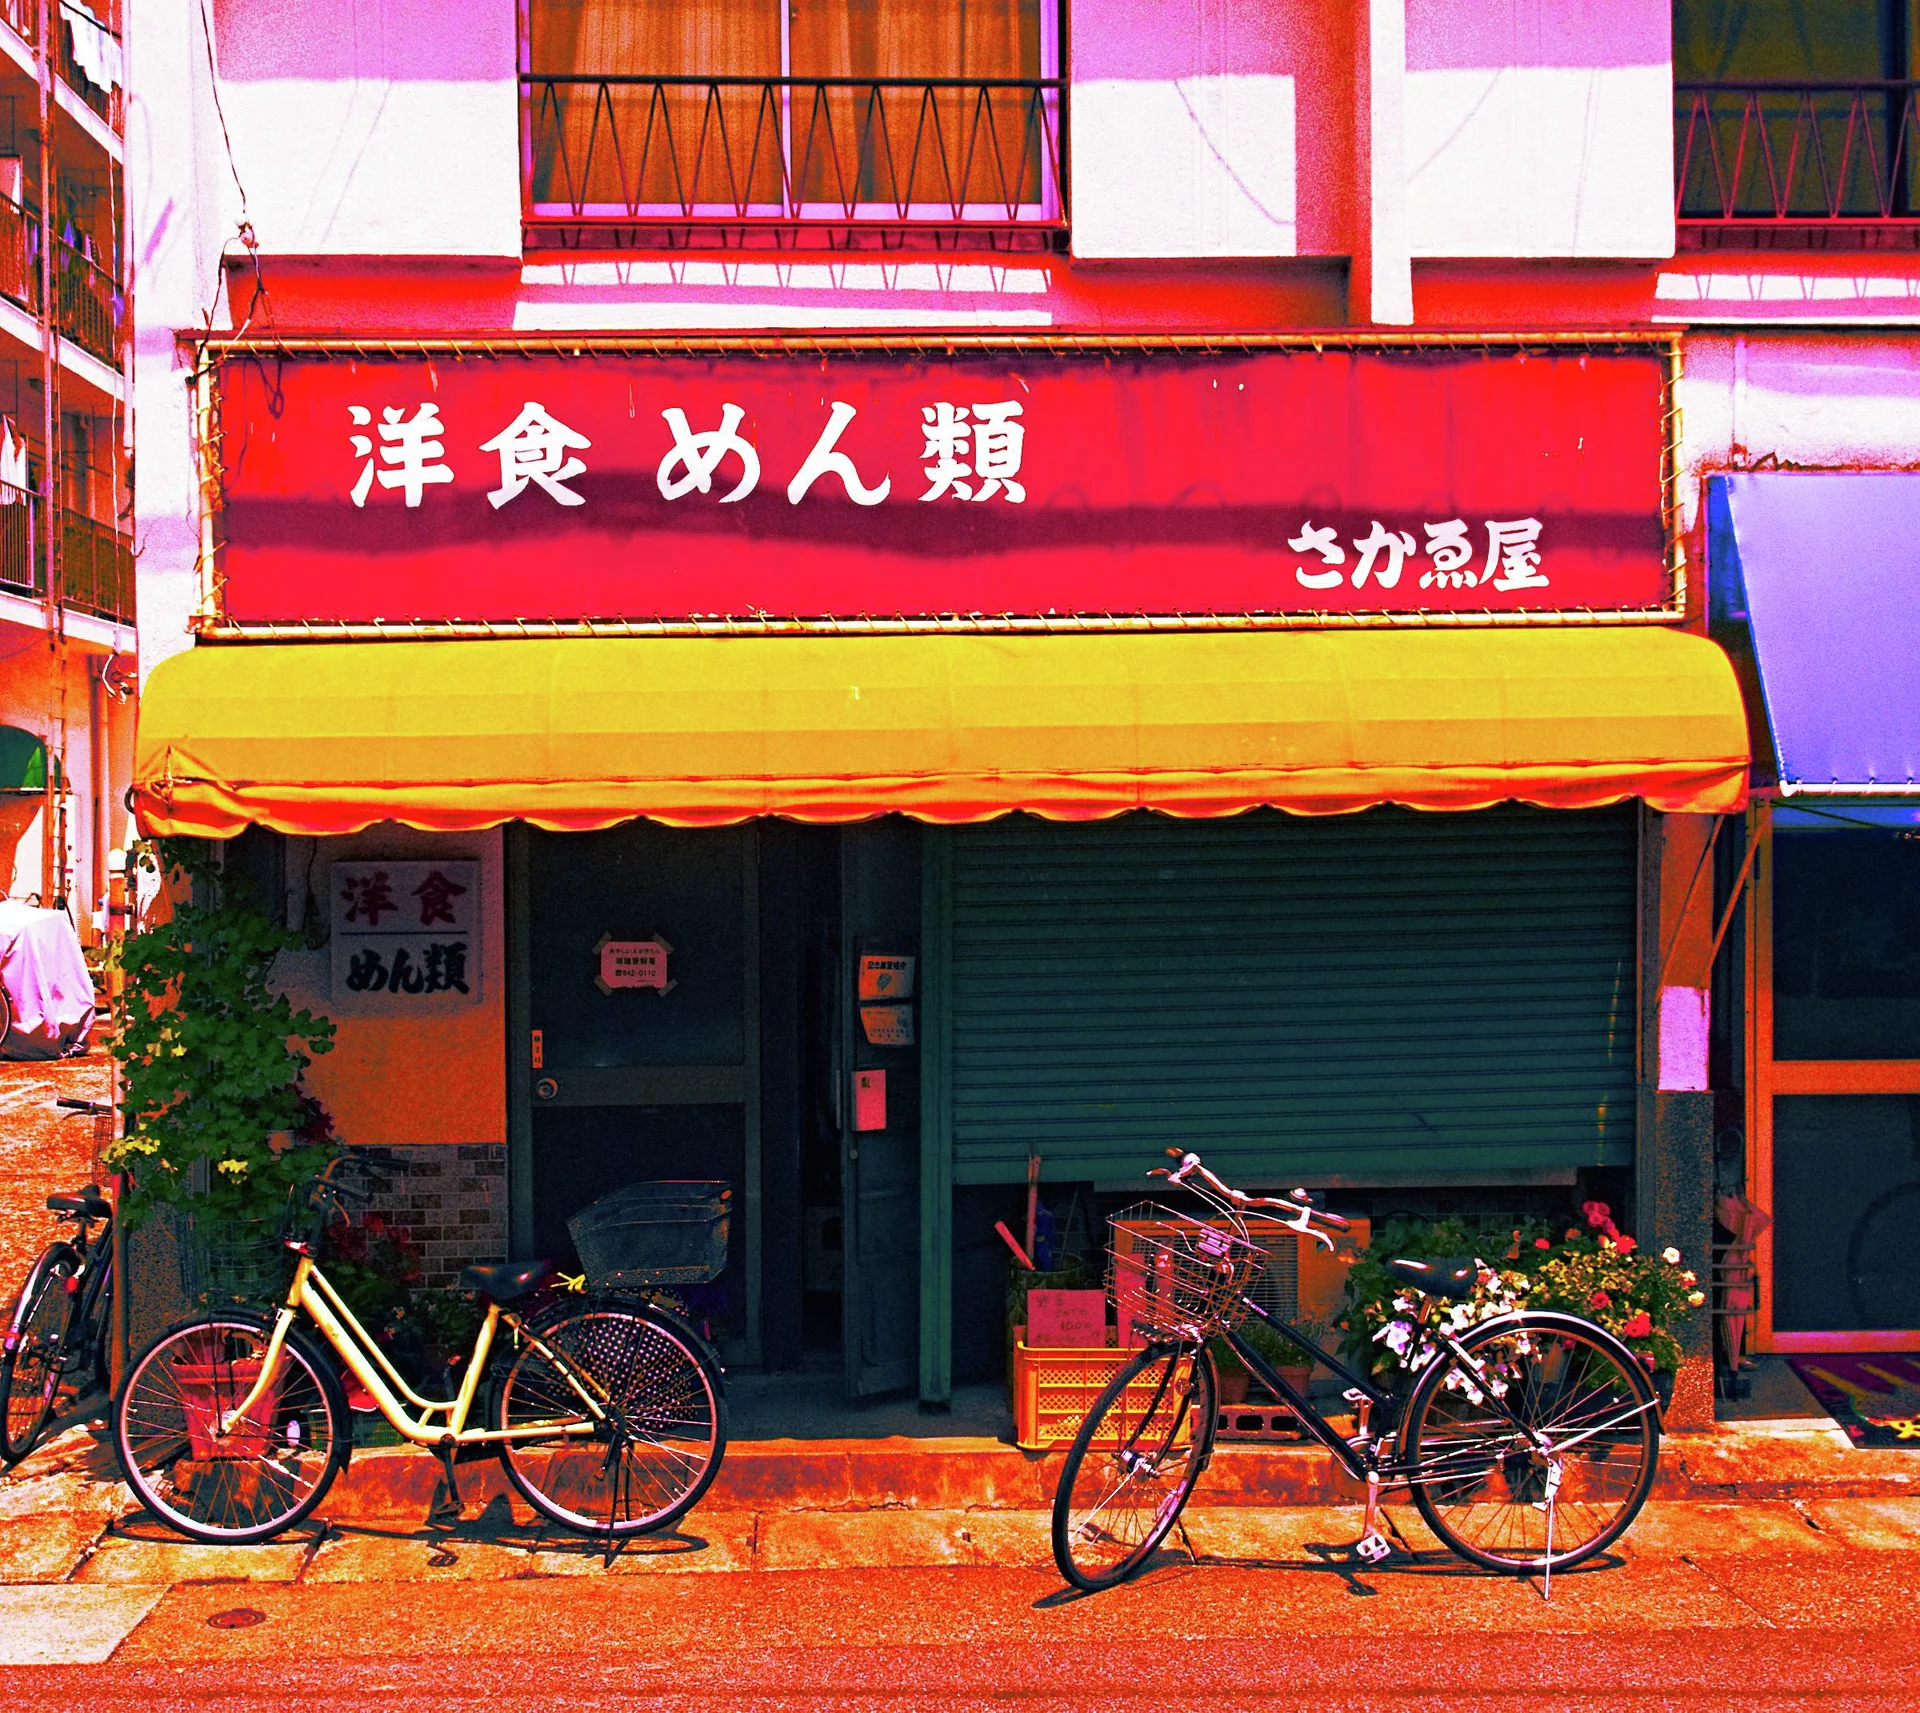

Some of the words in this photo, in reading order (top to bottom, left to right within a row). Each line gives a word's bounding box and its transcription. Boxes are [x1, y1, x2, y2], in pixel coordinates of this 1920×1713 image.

[348, 402, 591, 509] 洋食
[657, 401, 1025, 505] めん類
[1288, 518, 1549, 591] さかゑ屋
[340, 870, 467, 926] 洋食
[346, 941, 470, 994] めん類
